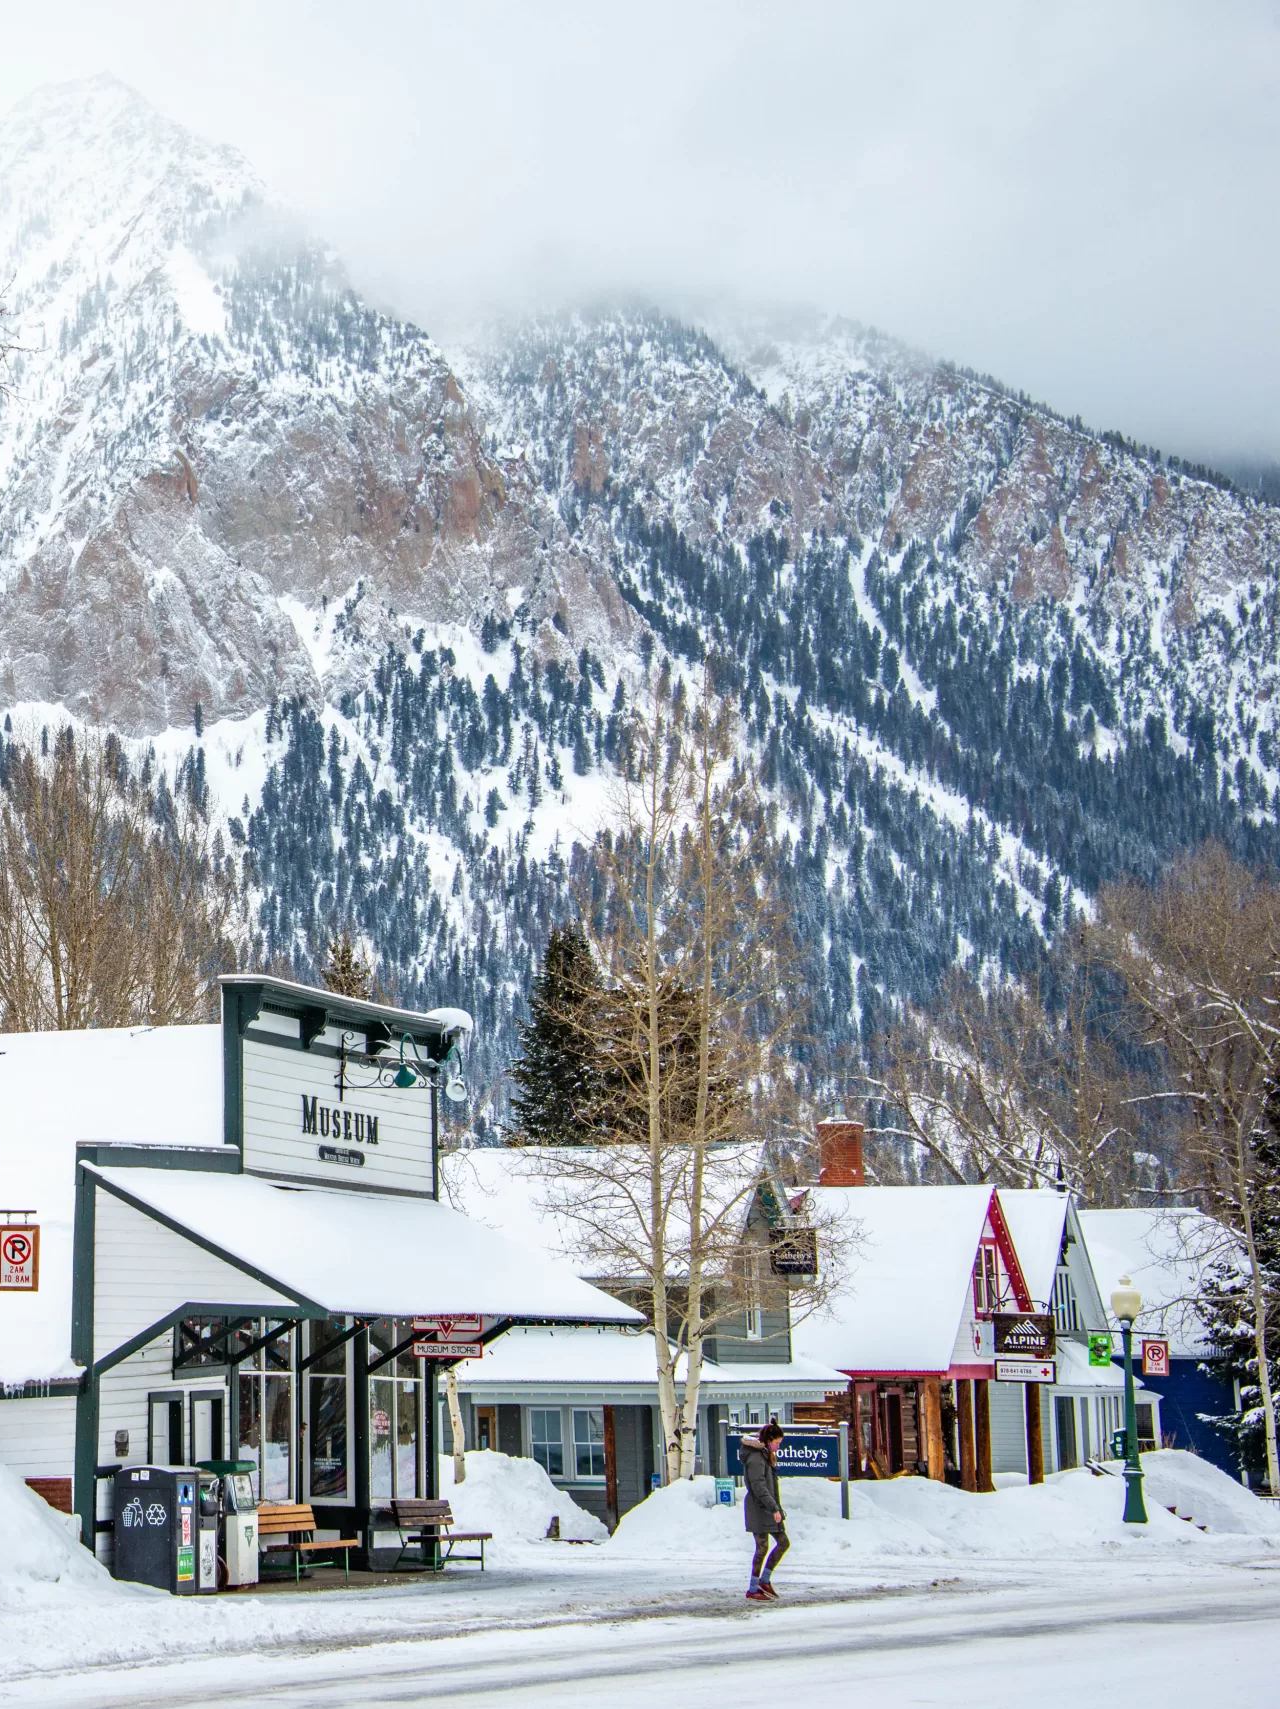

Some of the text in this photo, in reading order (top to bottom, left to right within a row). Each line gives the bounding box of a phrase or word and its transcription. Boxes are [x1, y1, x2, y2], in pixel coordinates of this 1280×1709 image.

[301, 1094, 379, 1144] MUSEUM
[1004, 1336, 1046, 1346] ALPINE
[773, 1445, 828, 1461] otheby's
